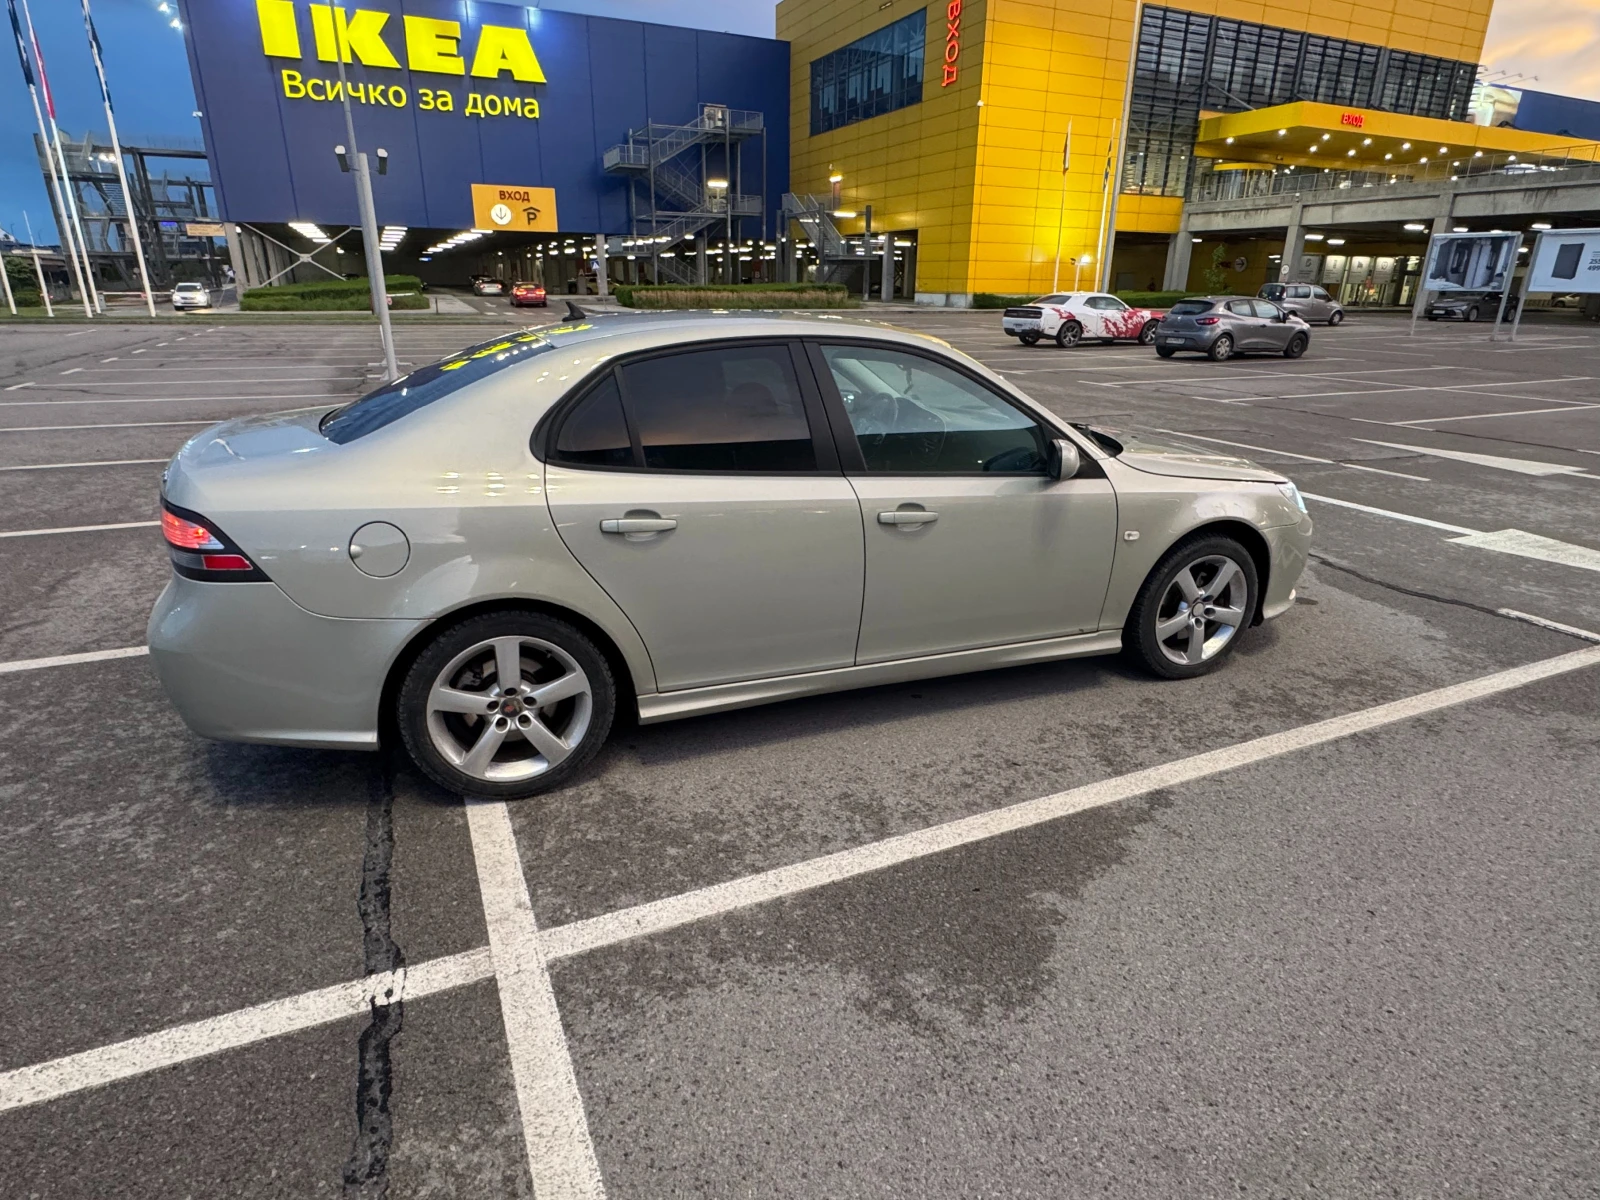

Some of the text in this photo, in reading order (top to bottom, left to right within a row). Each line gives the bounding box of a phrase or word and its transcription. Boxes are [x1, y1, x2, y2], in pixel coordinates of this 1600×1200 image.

[256, 0, 547, 83] IKEA
[941, 0, 961, 87] ВХОД
[281, 69, 540, 119] Всичко за дома
[1341, 112, 1365, 128] ВХОД
[499, 190, 530, 203] ВХОД
